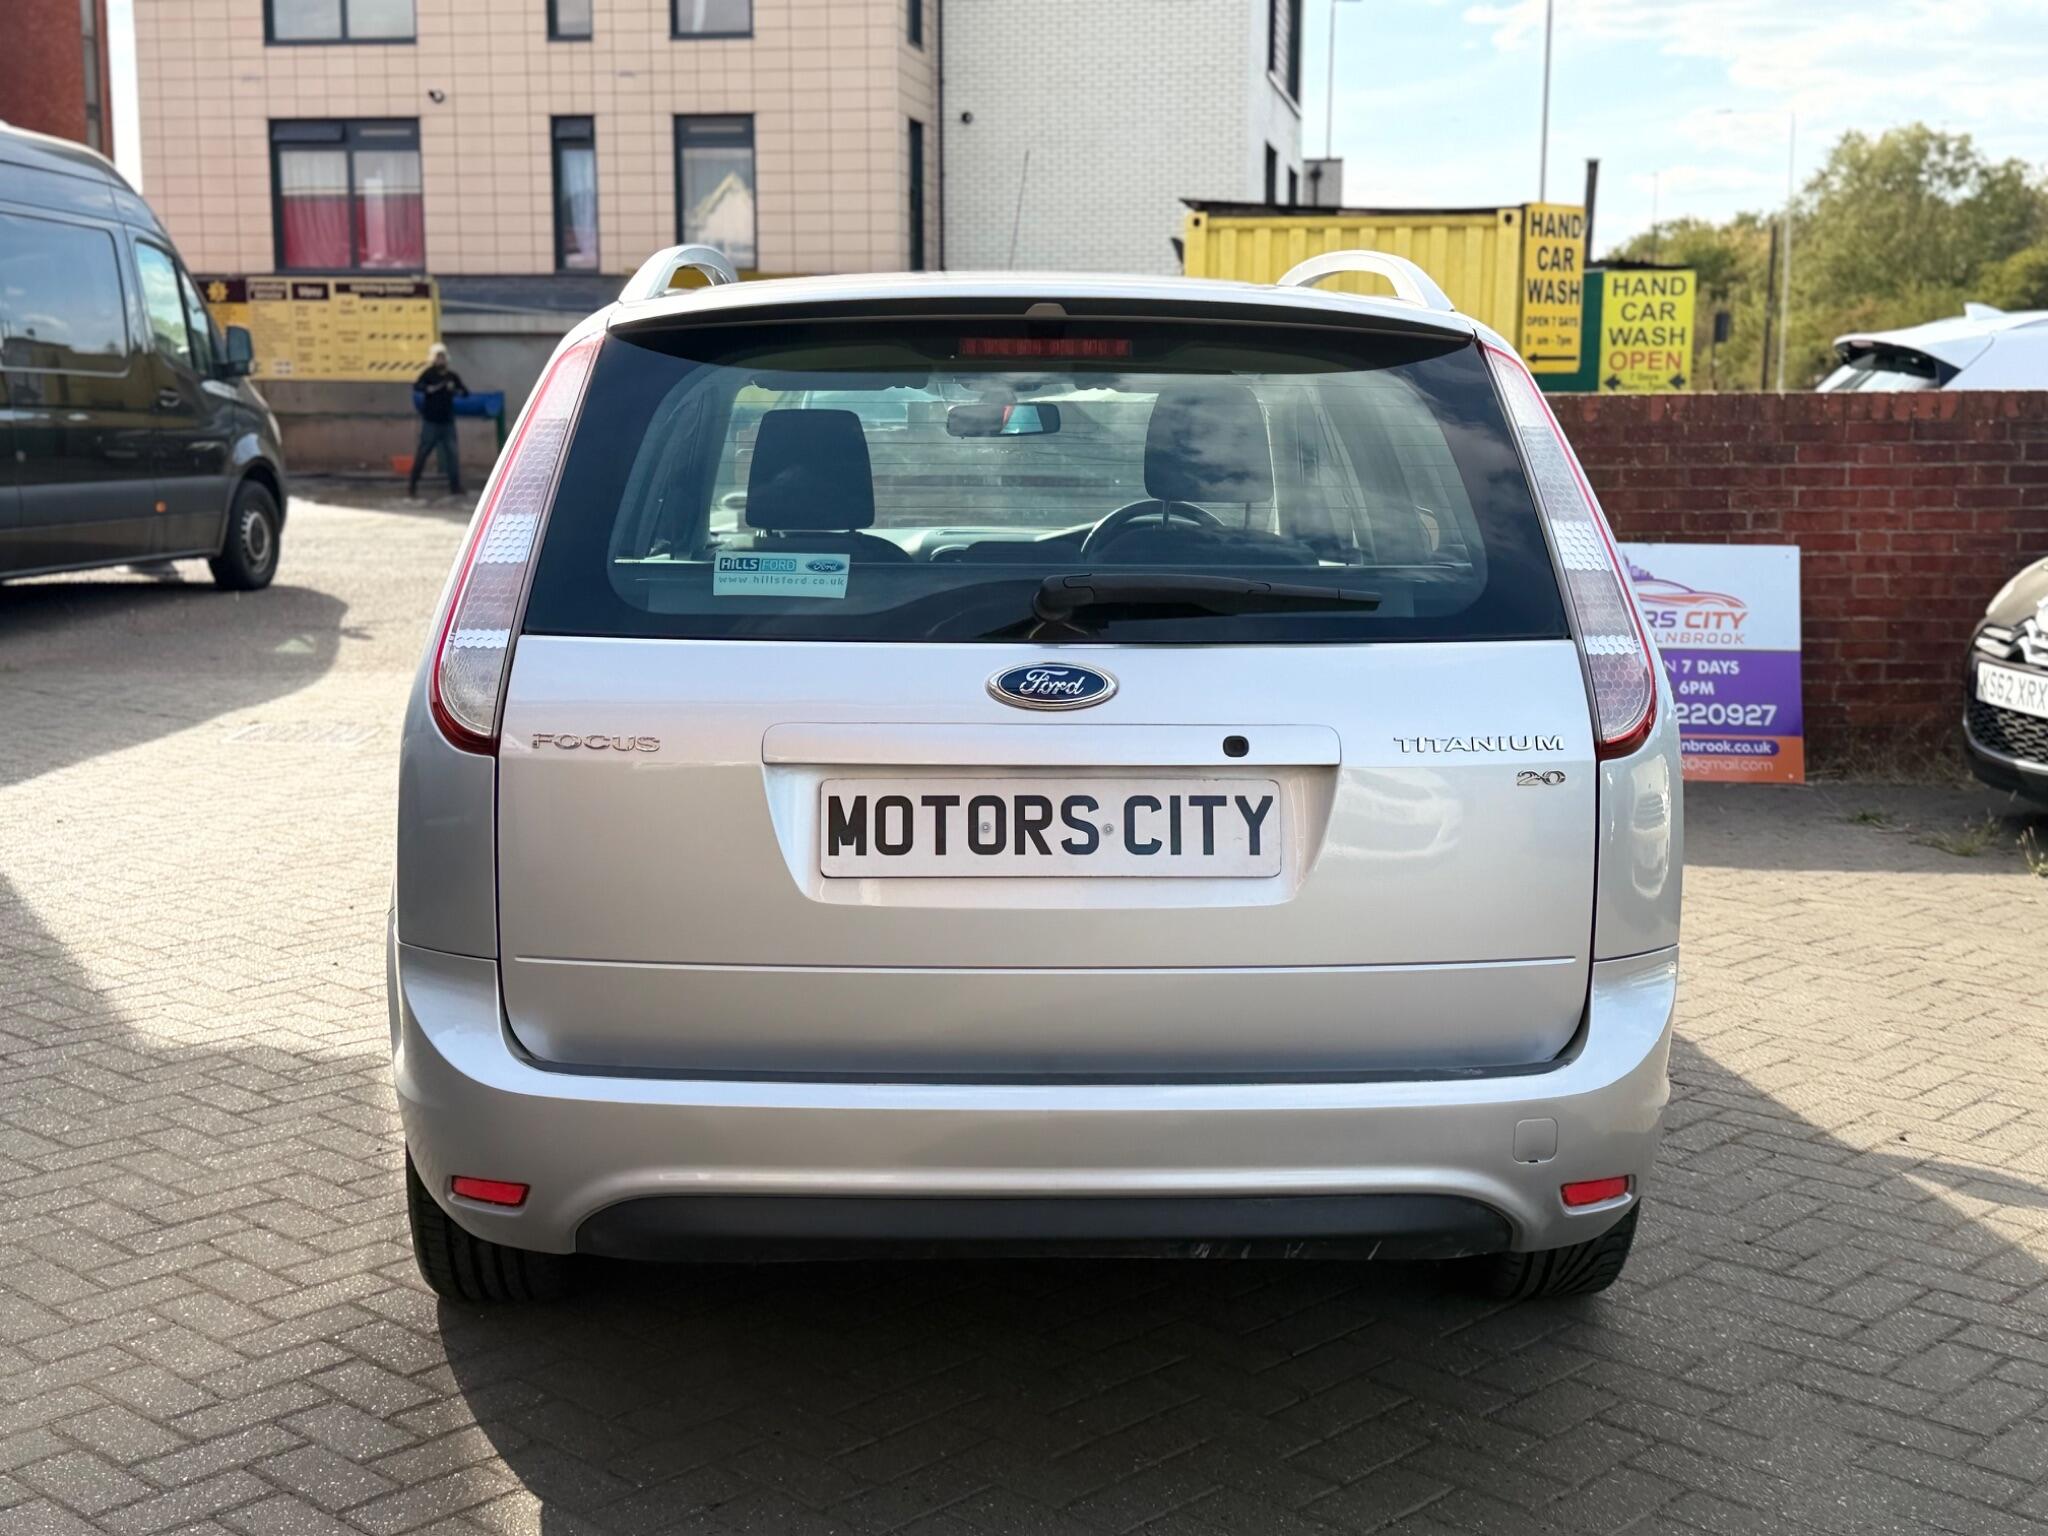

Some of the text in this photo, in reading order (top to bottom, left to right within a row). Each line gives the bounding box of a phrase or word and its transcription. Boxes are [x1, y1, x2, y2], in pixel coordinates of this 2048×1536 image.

[1530, 212, 1582, 239] HAND
[1537, 246, 1575, 272] CAR
[1527, 278, 1580, 305] WASH
[1612, 277, 1687, 297] HAND
[1620, 302, 1676, 322] CAR
[1609, 327, 1686, 347] WASH
[1609, 351, 1682, 372] OPEN
[761, 559, 796, 571] FORD
[1684, 611, 1748, 630] CITY
[1681, 659, 1692, 674] 7
[1697, 660, 1741, 676] DAYS
[1018, 668, 1086, 698] Ford
[1679, 680, 1715, 696] 6PM
[531, 732, 661, 753] FOCUS
[1393, 735, 1565, 754] TITANIUM
[827, 795, 1274, 856] MOTORS CITY
